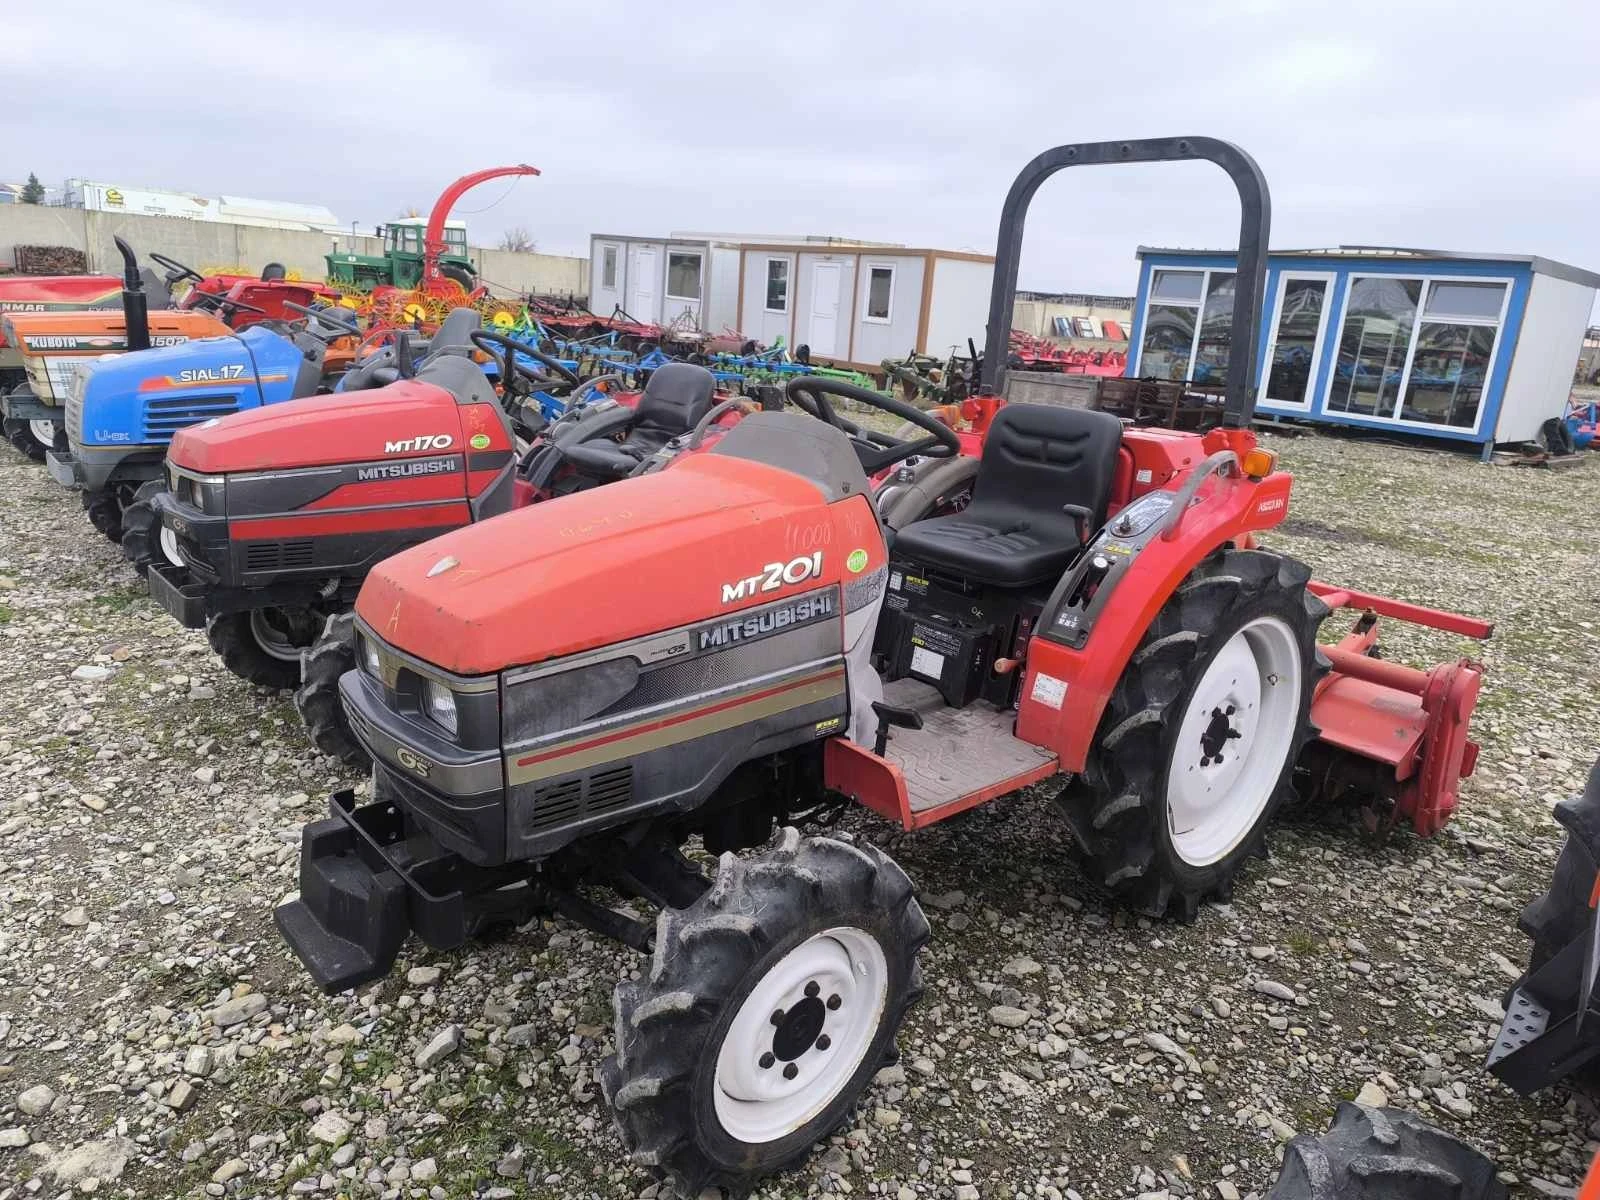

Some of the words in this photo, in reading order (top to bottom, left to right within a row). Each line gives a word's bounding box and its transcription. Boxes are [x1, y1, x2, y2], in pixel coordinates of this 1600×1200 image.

[31, 336, 77, 348] KUBOTA
[384, 434, 453, 453] MT170
[358, 460, 456, 481] MITSUBISHI
[722, 551, 823, 603] MT201
[701, 597, 833, 649] MITSUBISHI
[397, 748, 429, 777] GS
